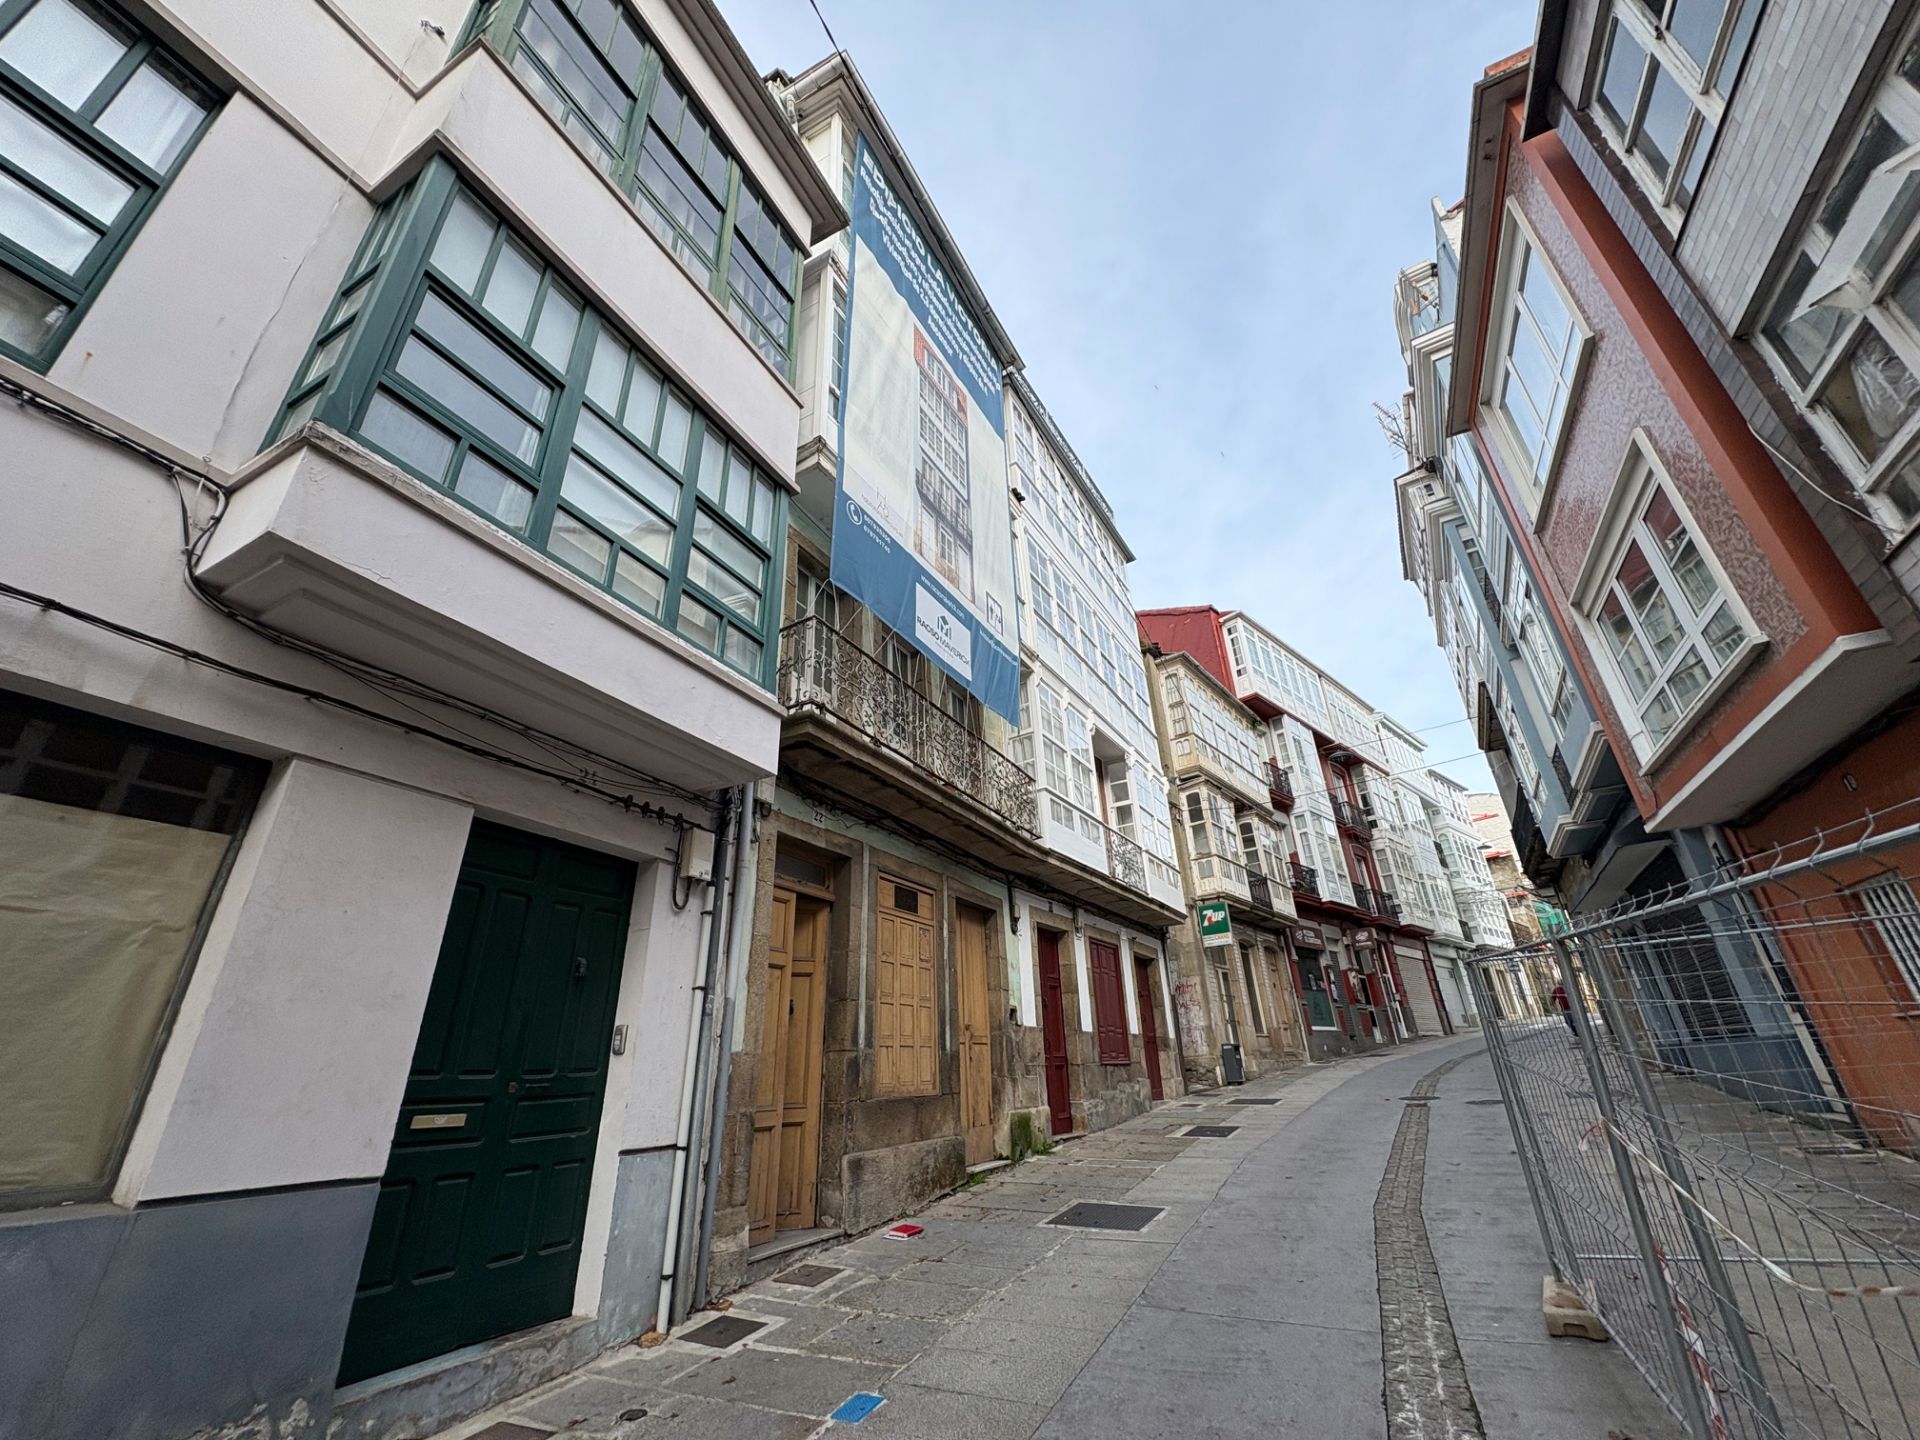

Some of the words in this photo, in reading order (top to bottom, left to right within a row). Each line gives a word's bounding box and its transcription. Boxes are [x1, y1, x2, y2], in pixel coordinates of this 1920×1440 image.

[862, 147, 926, 257] EDIFICIO
[928, 252, 946, 290] LA
[946, 281, 998, 374] VICTORIA
